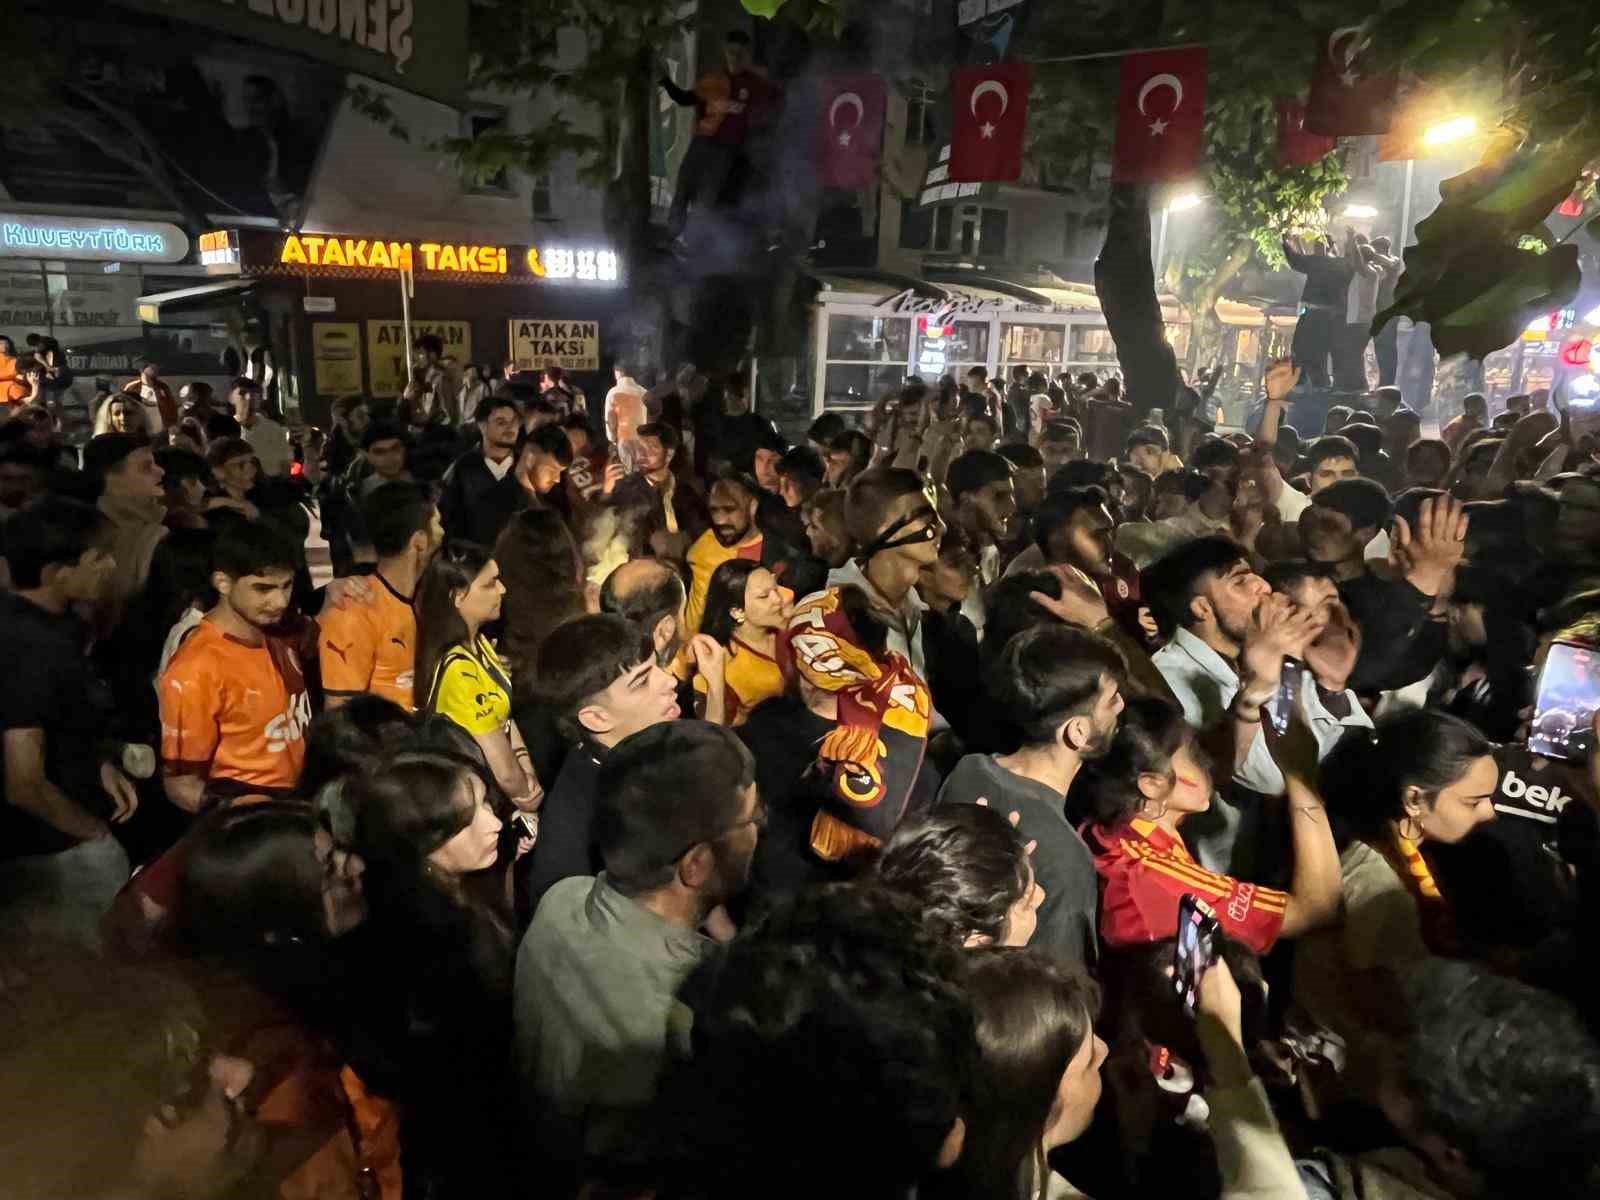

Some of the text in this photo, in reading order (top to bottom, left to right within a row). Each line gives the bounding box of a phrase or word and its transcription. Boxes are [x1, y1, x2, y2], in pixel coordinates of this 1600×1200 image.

[281, 236, 411, 270] ATAKAN
[519, 322, 595, 338] ATAKAN
[1501, 770, 1573, 813] bek
